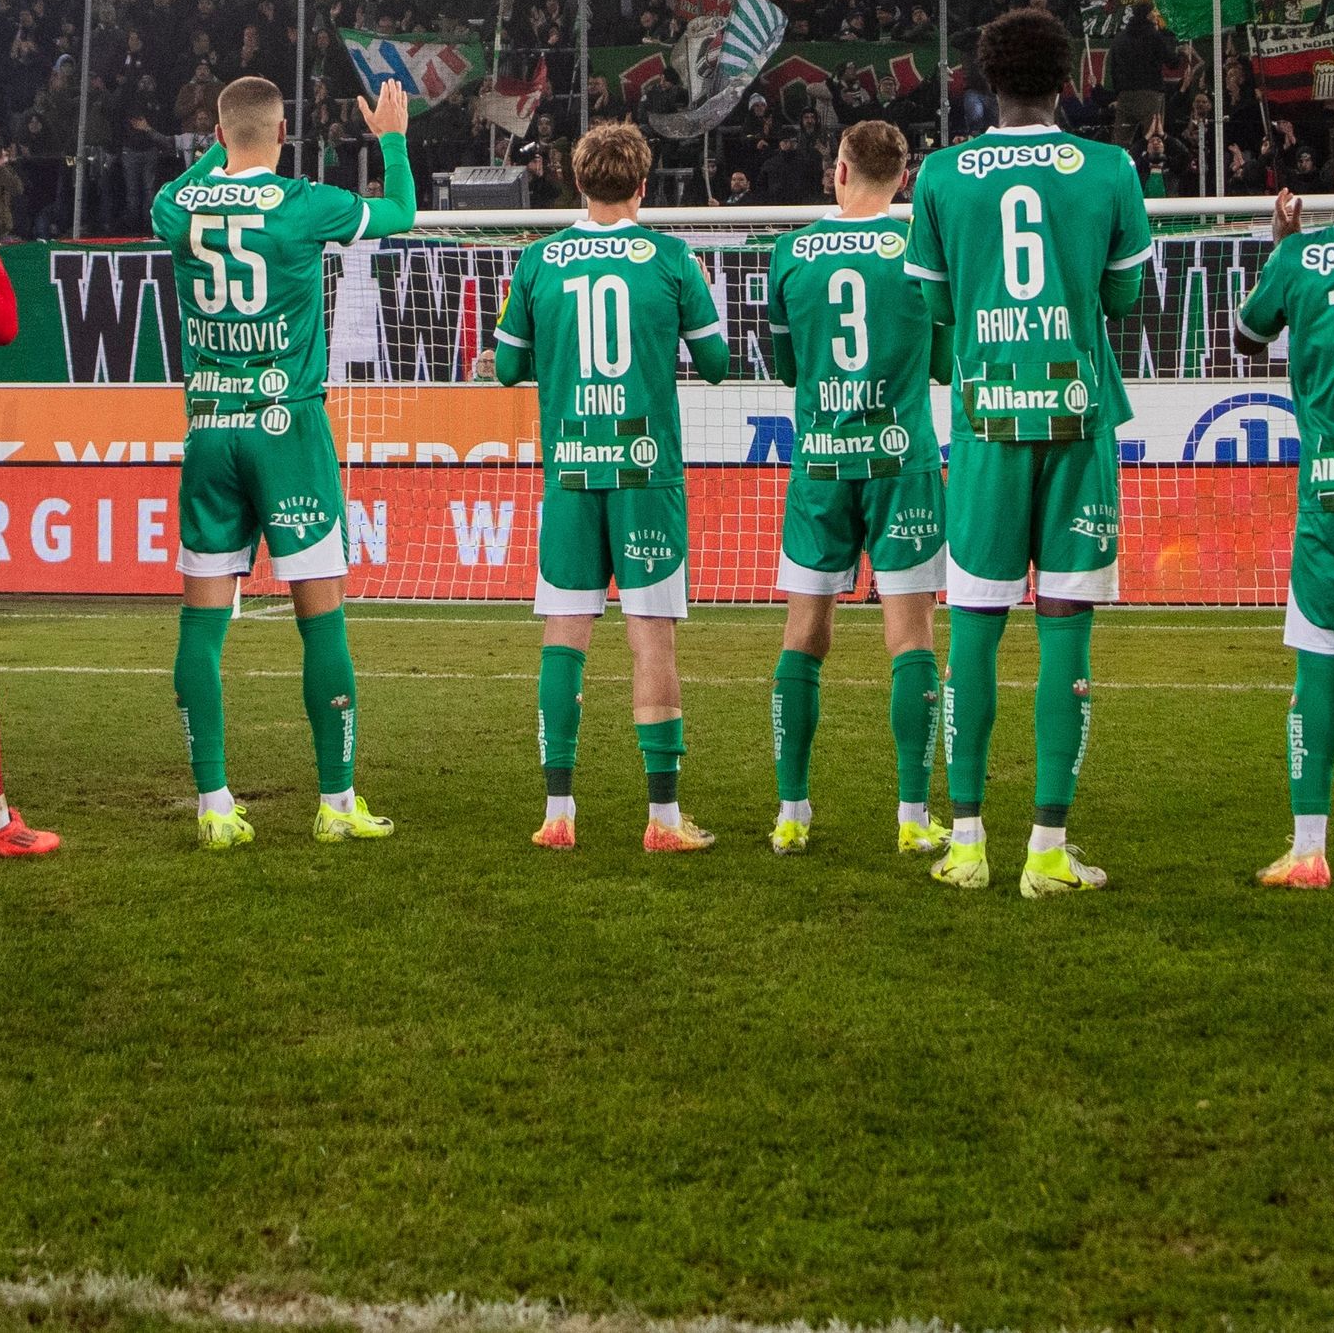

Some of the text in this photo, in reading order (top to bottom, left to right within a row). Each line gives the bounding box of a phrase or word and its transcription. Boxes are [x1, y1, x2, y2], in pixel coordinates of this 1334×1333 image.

[958, 146, 1053, 177] spusu
[176, 184, 261, 211] spusu
[543, 237, 630, 266] spusu
[793, 231, 877, 262] spusu
[1000, 184, 1046, 301] 6
[189, 214, 269, 316] 55
[187, 314, 289, 353] CVETKOVIĆ
[563, 275, 632, 379] 10
[828, 268, 869, 372] 3
[976, 305, 1075, 344] RAUX-YA
[189, 371, 256, 394] Allianz
[818, 378, 886, 413] BÖCKLE
[976, 385, 1059, 410] Allianz
[574, 383, 626, 417] LANG
[554, 441, 625, 464] Allianz
[801, 432, 875, 455] Allianz
[270, 511, 328, 529] ZUCKER
[278, 497, 320, 512] WIENER
[628, 529, 668, 545] WIENER
[887, 520, 941, 538] ZUCKER
[624, 542, 674, 559] ZUCKER
[341, 708, 355, 764] easystaff
[1290, 713, 1309, 780] easystaff
